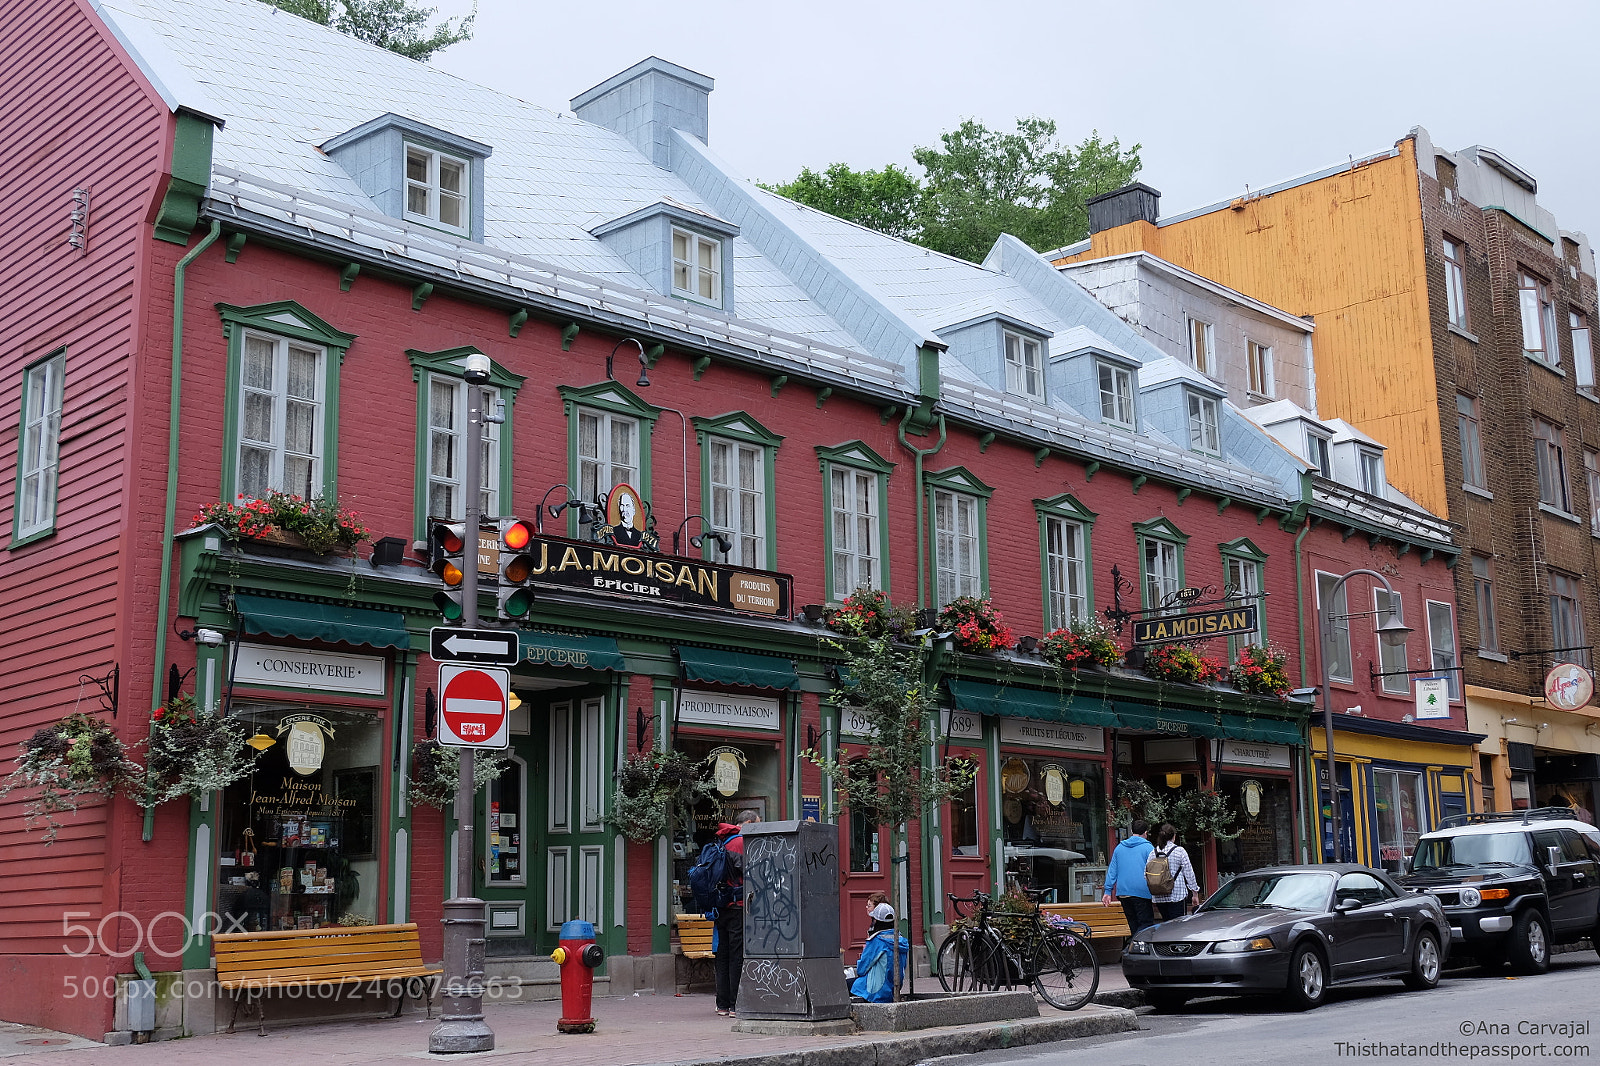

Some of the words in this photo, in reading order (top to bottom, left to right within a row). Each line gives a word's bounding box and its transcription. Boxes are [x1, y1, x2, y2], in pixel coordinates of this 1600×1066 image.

[642, 531, 658, 548] 1871
[532, 542, 719, 602] J.A.MOISAN
[740, 579, 771, 592] PRODUITS
[736, 593, 746, 603] DU
[747, 595, 775, 607] TERROIR
[1180, 590, 1195, 598] 1871
[1140, 611, 1247, 640] J.A.MOISAN
[263, 658, 356, 679] CONSERVERIE
[684, 700, 732, 715] PRODUITS
[733, 705, 770, 719] MAISON
[951, 716, 972, 732] 689
[1021, 726, 1045, 738] FRUITS
[1046, 729, 1054, 739] ET
[1055, 728, 1085, 742] LÉGUMES
[1320, 769, 1329, 780] 67
[280, 776, 322, 791] Maison
[249, 790, 314, 808] Jean-Alfred
[316, 793, 357, 808] Moisan
